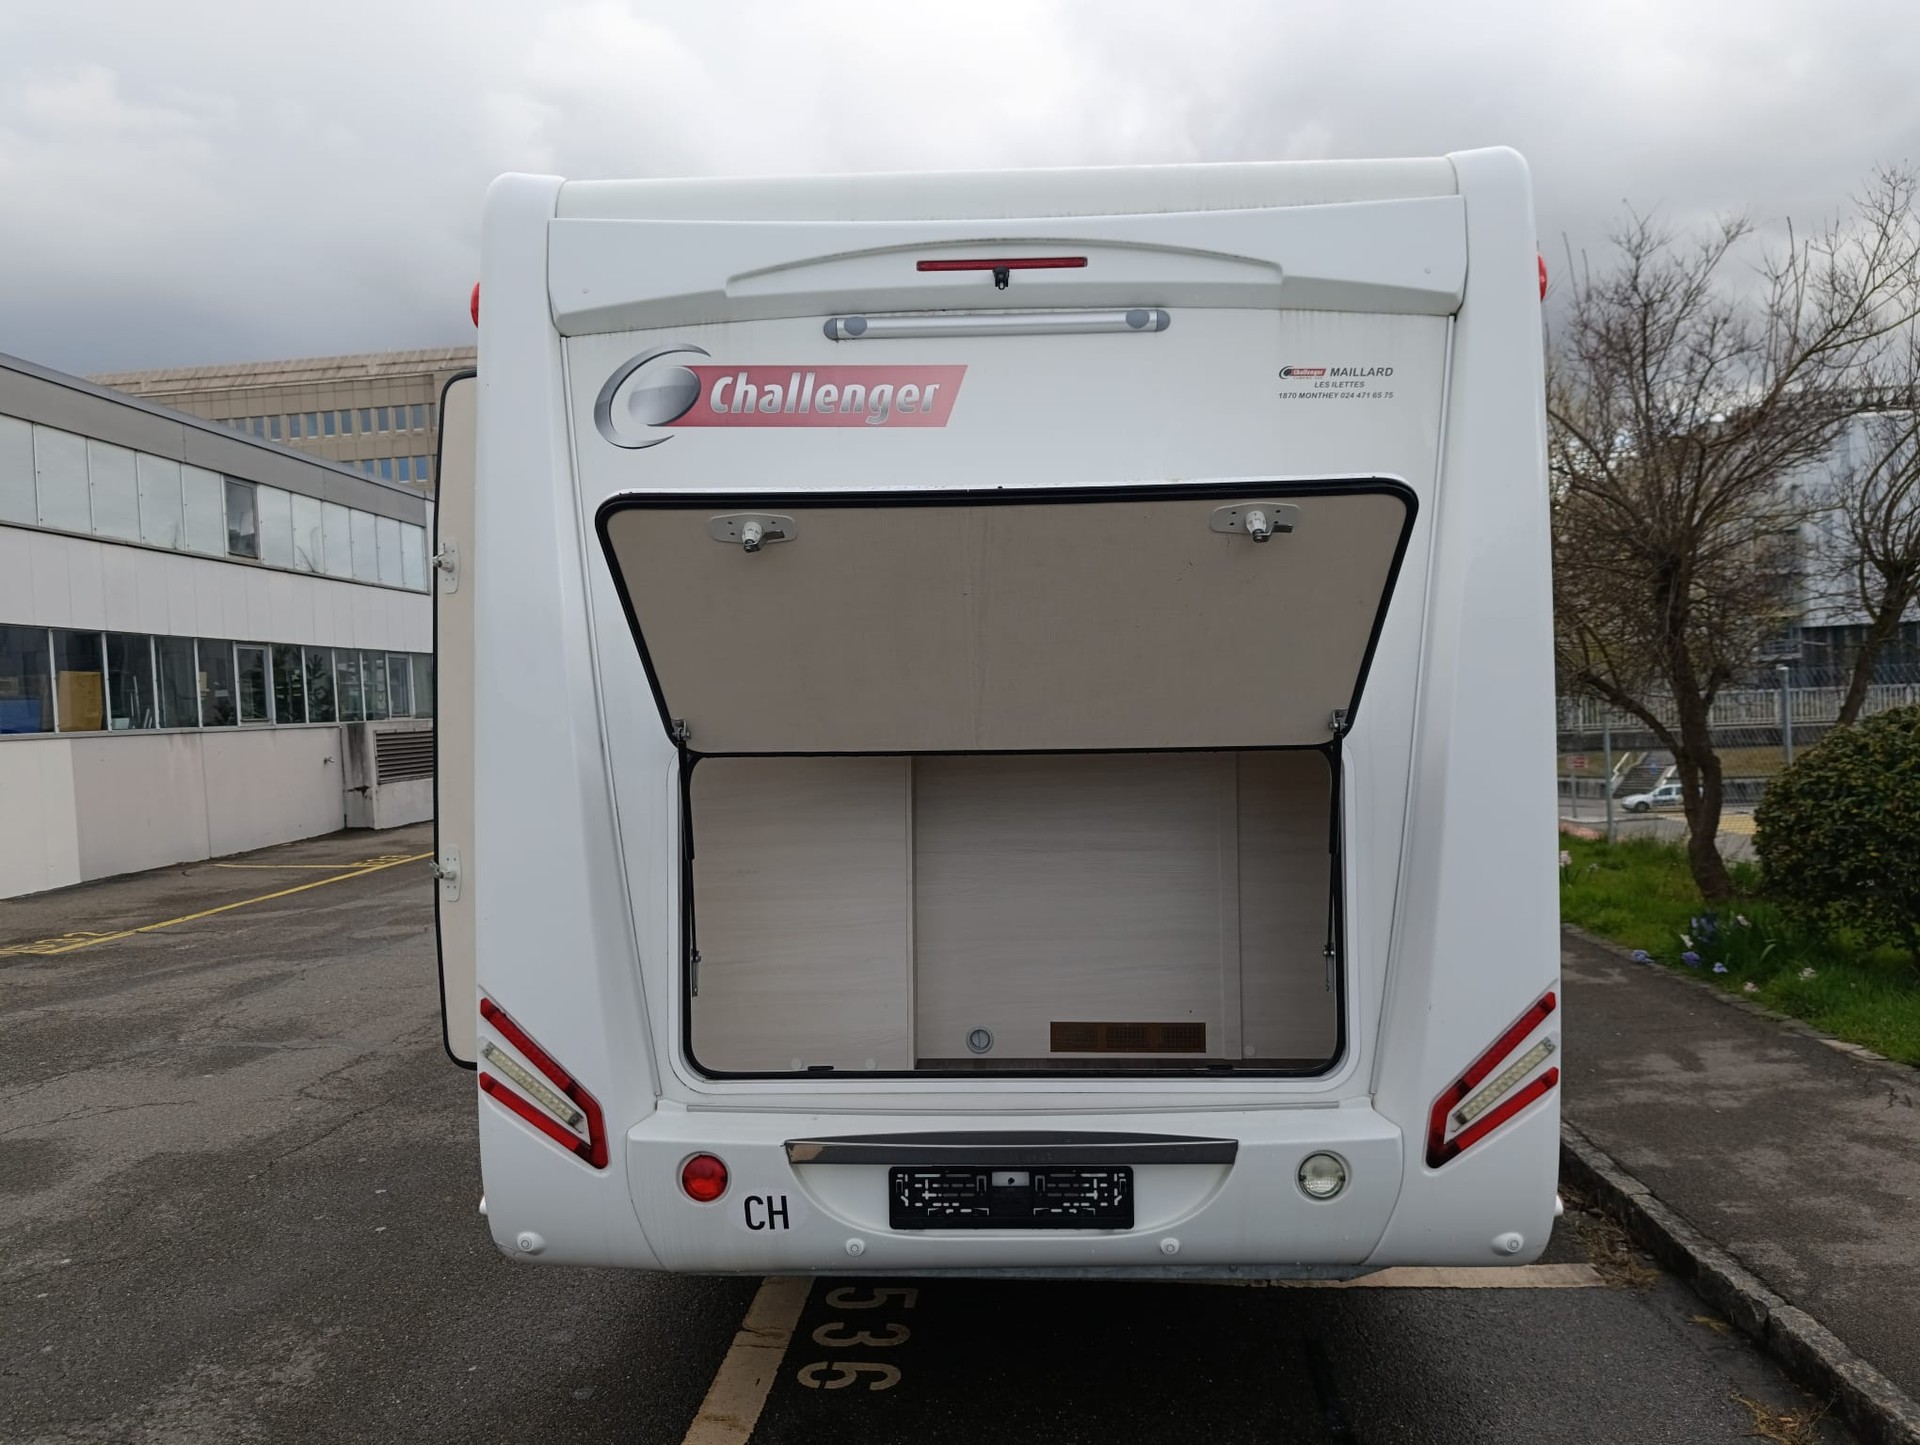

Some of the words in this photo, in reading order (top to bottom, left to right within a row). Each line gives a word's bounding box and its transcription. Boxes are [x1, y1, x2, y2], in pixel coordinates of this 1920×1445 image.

[1330, 367, 1394, 377] MAILLARD
[709, 371, 941, 425] Challenger
[1383, 391, 1394, 399] 75
[743, 1195, 791, 1231] CH
[796, 1286, 919, 1391] 536
